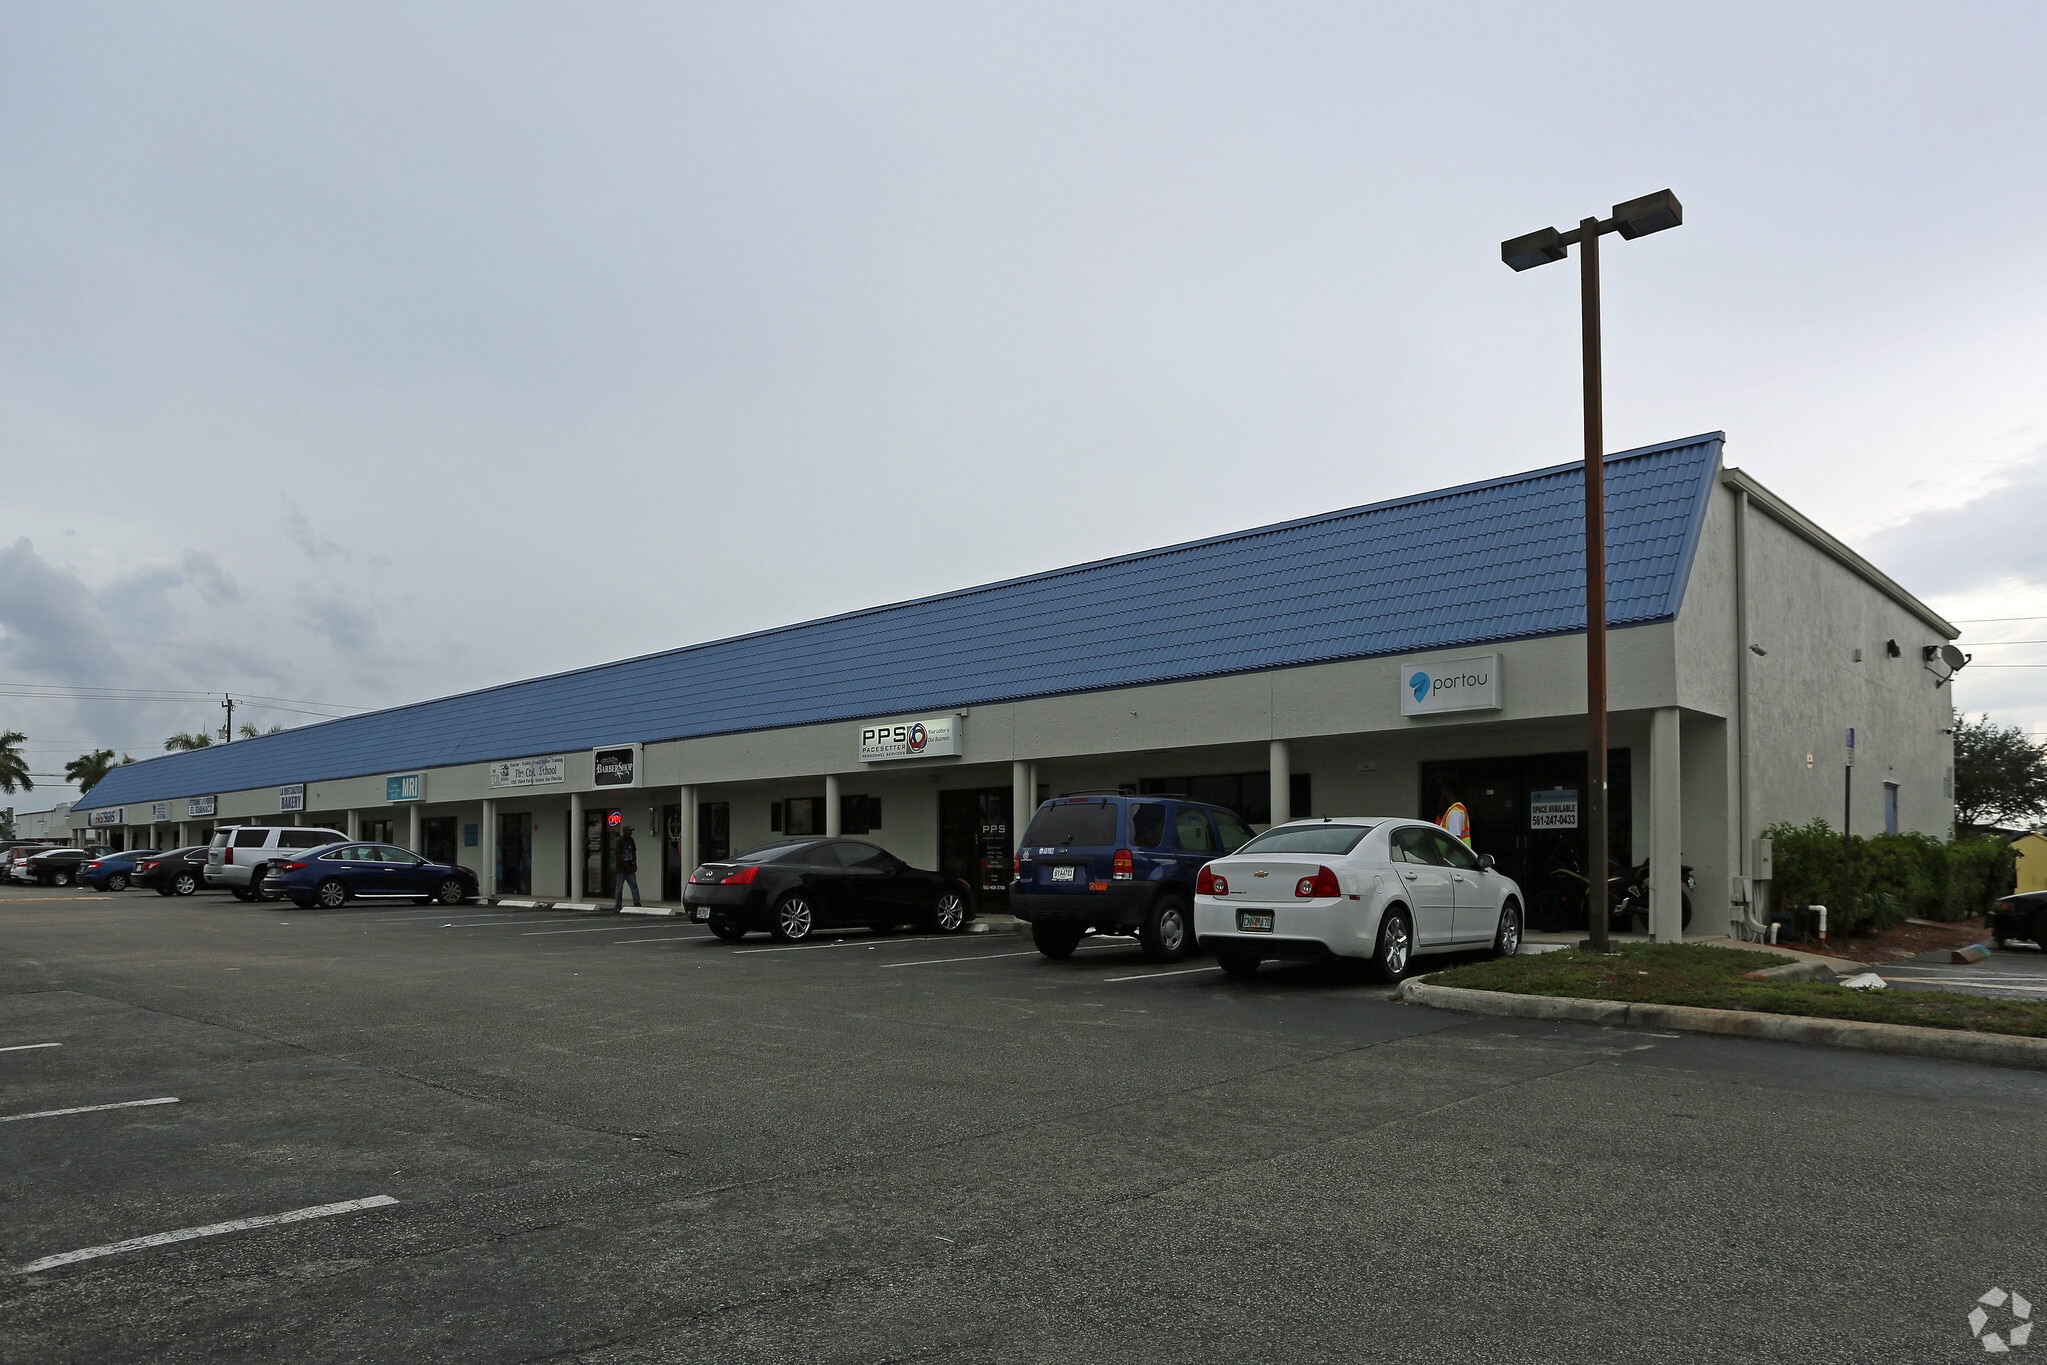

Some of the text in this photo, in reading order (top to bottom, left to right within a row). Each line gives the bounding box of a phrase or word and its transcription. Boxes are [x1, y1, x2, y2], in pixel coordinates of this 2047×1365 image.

[1433, 673, 1487, 696] portou
[863, 726, 906, 745] PPS
[862, 744, 906, 753] PACESETTER
[539, 765, 557, 776] School
[402, 777, 418, 797] MRI
[281, 795, 301, 809] BAKERY
[1532, 804, 1576, 814] SPACE AVAILABLE
[1532, 814, 1576, 826] 561-247-0433
[983, 825, 1006, 834] PPS
